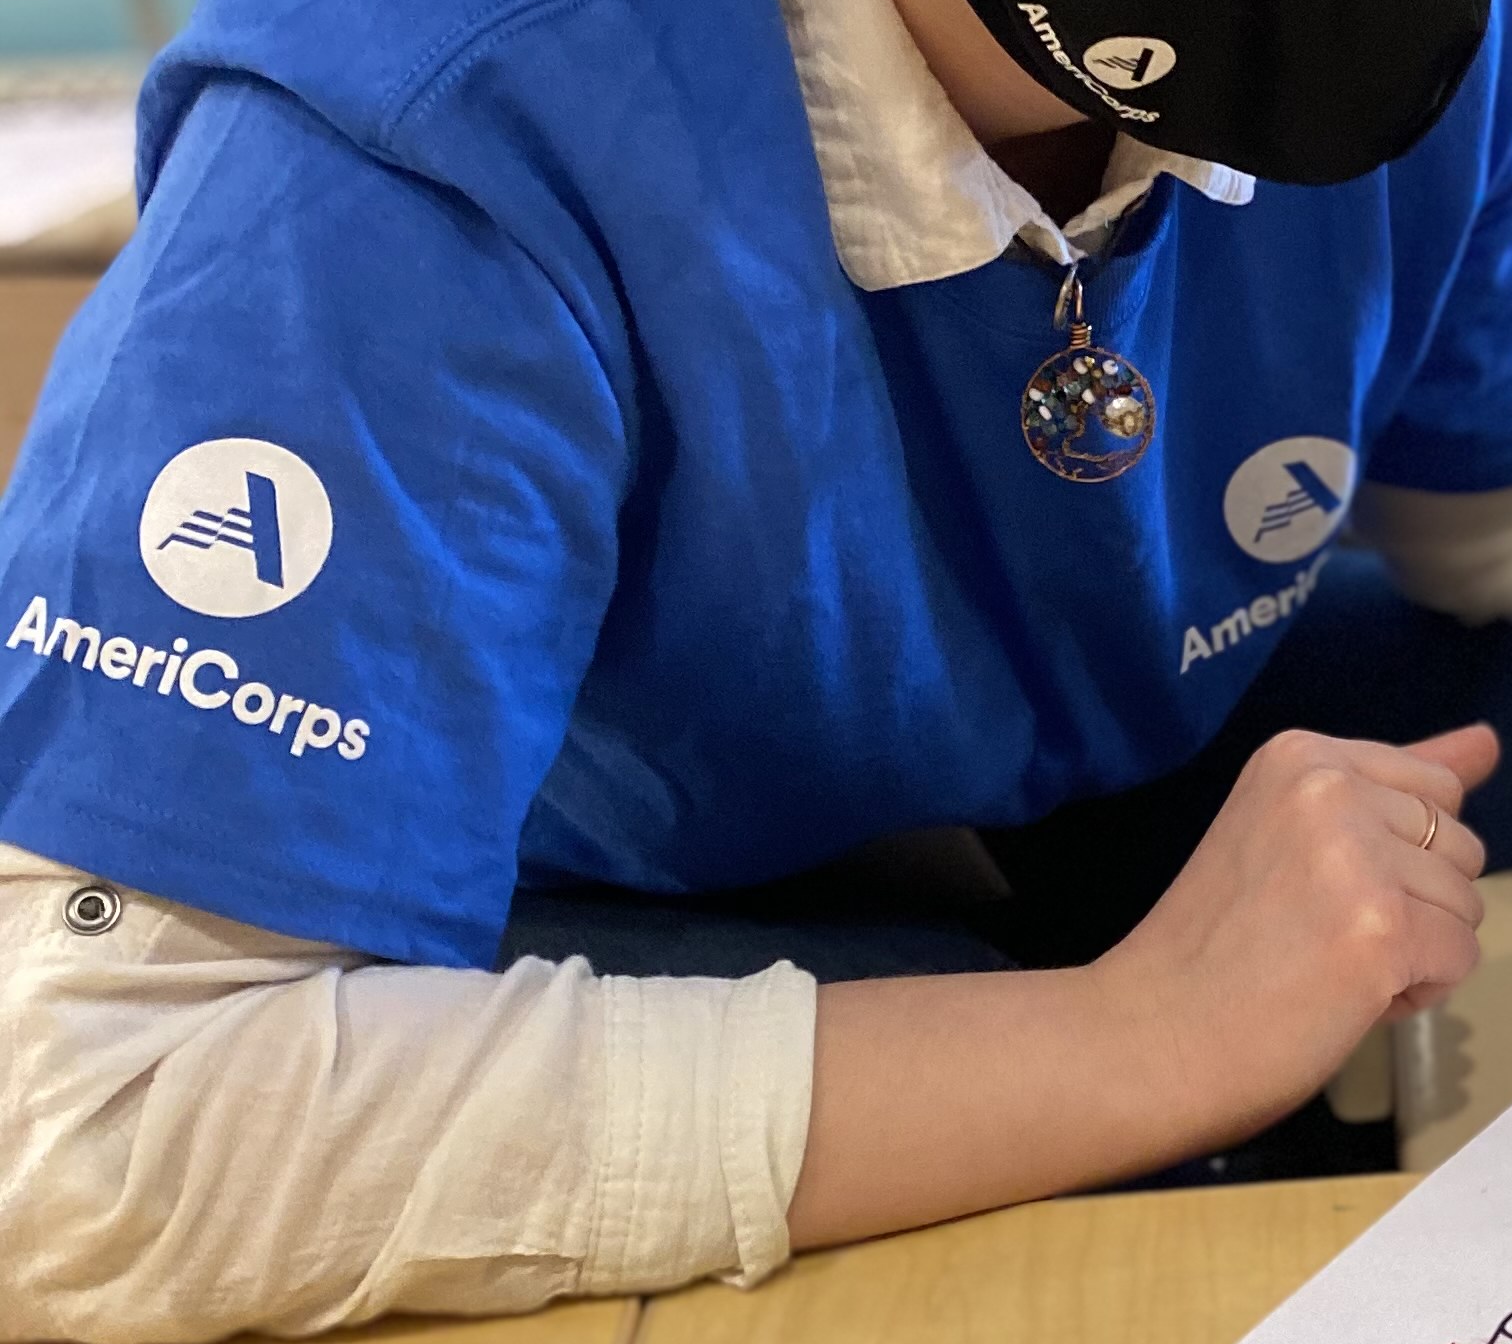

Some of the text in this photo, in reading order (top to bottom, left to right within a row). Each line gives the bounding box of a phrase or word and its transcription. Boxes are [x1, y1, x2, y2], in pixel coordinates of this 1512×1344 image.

[1017, 3, 1160, 123] AmeriCorps
[1179, 549, 1332, 676] Ameri
[6, 595, 371, 761] AmeriCorps
